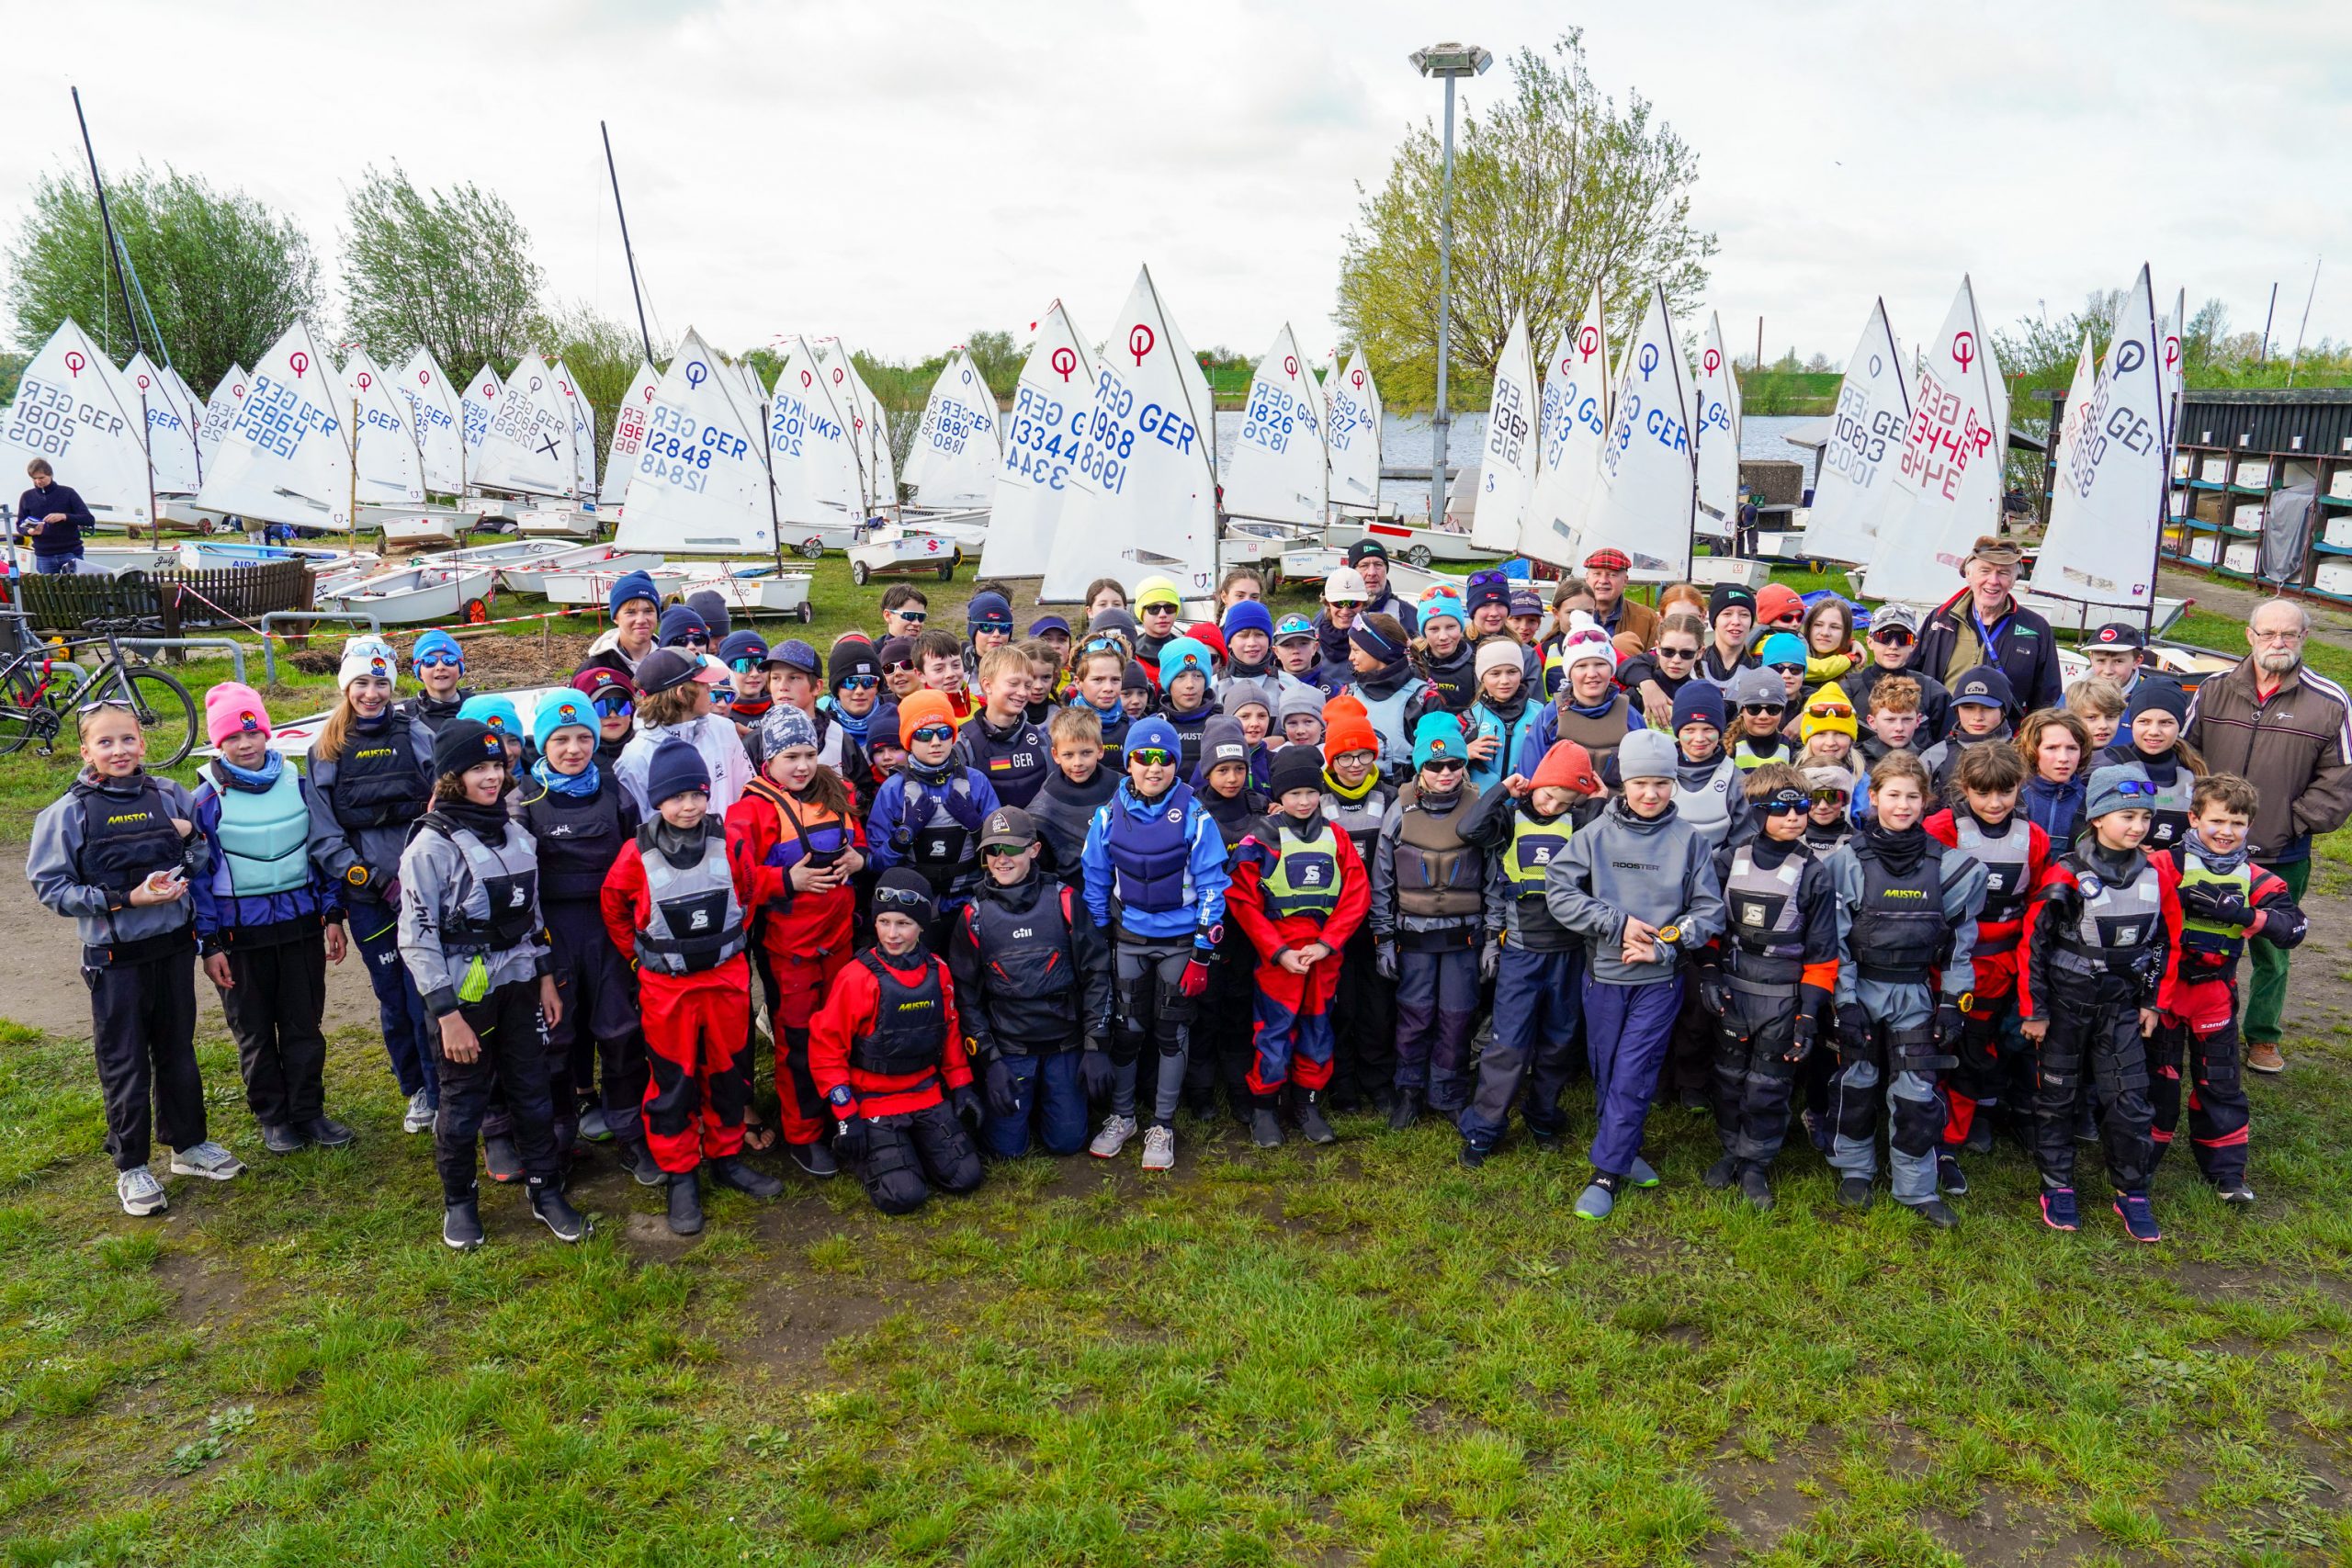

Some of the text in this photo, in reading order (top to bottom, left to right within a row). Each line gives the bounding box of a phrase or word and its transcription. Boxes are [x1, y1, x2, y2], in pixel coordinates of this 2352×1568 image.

[17, 400, 77, 437] 1805
[78, 403, 124, 437] GER
[147, 408, 181, 432] GER
[242, 394, 309, 442] 12864
[299, 400, 339, 438] GER
[368, 409, 401, 434] GER
[424, 404, 453, 431] GER
[499, 402, 540, 436] 12068
[536, 408, 566, 436] GER
[772, 413, 805, 438] 201
[808, 412, 842, 444] UKR
[936, 415, 969, 439] 1880
[1138, 402, 1195, 457] GER
[1249, 400, 1295, 434] 1826
[1296, 402, 1317, 436] GER
[701, 426, 748, 462] GER
[1010, 415, 1080, 466] 13344
[1089, 405, 1136, 459] 1968
[1646, 409, 1687, 456] GER
[1907, 407, 1972, 471] 13446
[644, 428, 713, 470] 12848
[154, 556, 178, 569] July
[731, 588, 752, 598] MSC
[355, 748, 392, 760] MUSTO
[1012, 752, 1035, 769] GER
[107, 812, 148, 825] MUSTO
[1611, 861, 1661, 873] ROOSTER
[1883, 888, 1922, 899] MUSTO
[1012, 928, 1033, 939] Gill
[379, 948, 400, 965] HH
[899, 1000, 931, 1011] MUSTO
